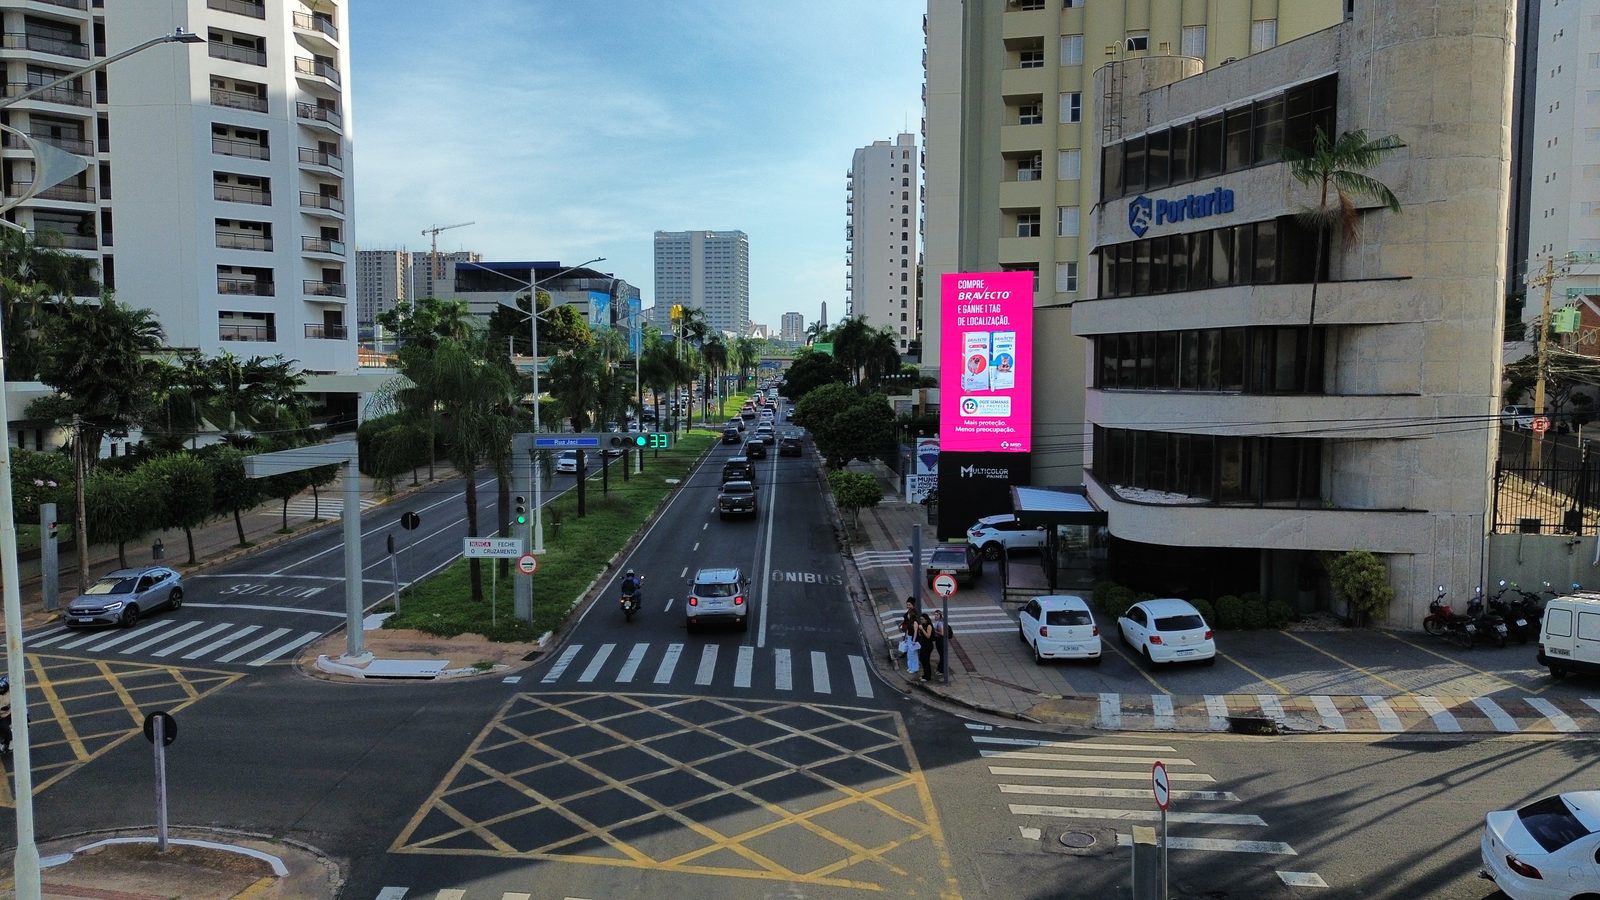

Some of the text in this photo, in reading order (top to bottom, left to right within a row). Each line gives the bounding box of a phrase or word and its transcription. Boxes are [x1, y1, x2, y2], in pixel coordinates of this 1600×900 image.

[1156, 187, 1234, 225] Portaria
[957, 279, 984, 289] COMPRE
[957, 305, 962, 314] E
[963, 305, 983, 314] GANHE
[989, 304, 1001, 313] TAG
[957, 315, 1010, 326] DE LOCALIZAÇÃO.
[976, 426, 1016, 434] preocupação.
[650, 434, 667, 448] 33
[960, 464, 1009, 478] MULTICOLOR
